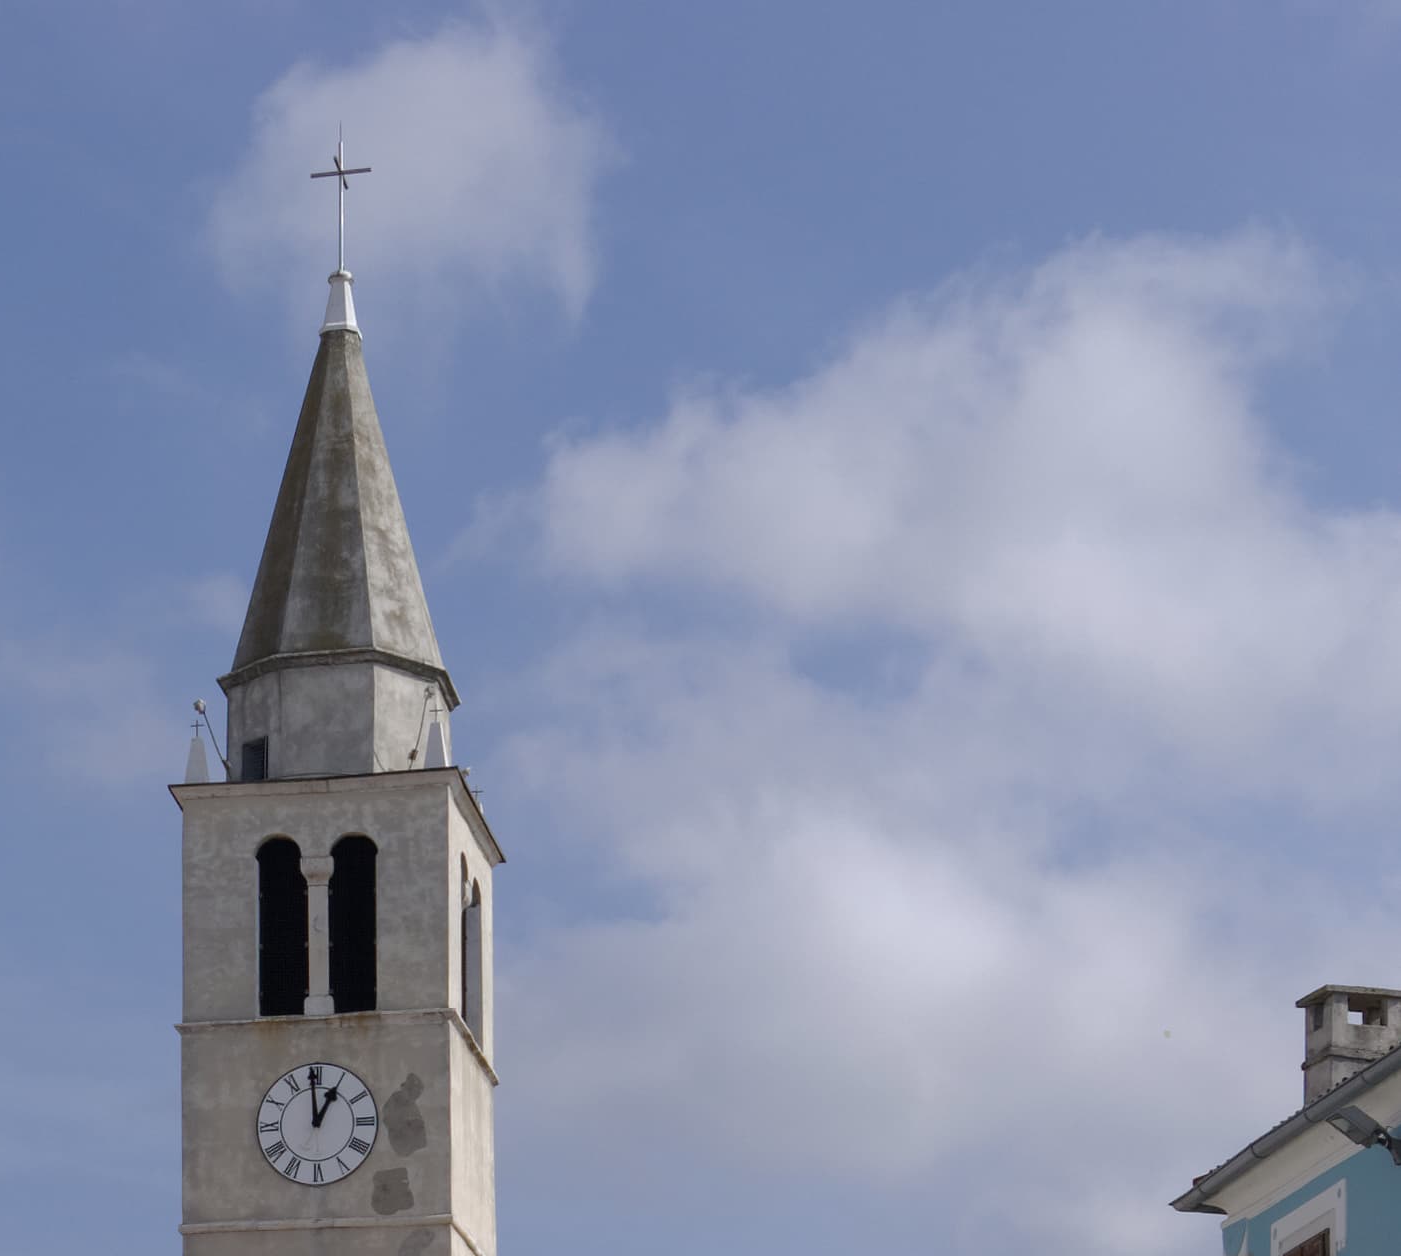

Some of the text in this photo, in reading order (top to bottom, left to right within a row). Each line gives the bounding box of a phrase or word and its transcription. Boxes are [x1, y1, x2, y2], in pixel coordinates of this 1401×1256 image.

[284, 1074, 300, 1094] XI
[266, 1095, 284, 1111] X
[350, 1090, 368, 1104] II
[259, 1121, 279, 1133] IX
[355, 1116, 375, 1126] III
[265, 1140, 287, 1163] VIII
[349, 1137, 370, 1155] IIII
[284, 1157, 301, 1179] VII
[313, 1163, 324, 1182] VI
[336, 1156, 350, 1174] V
